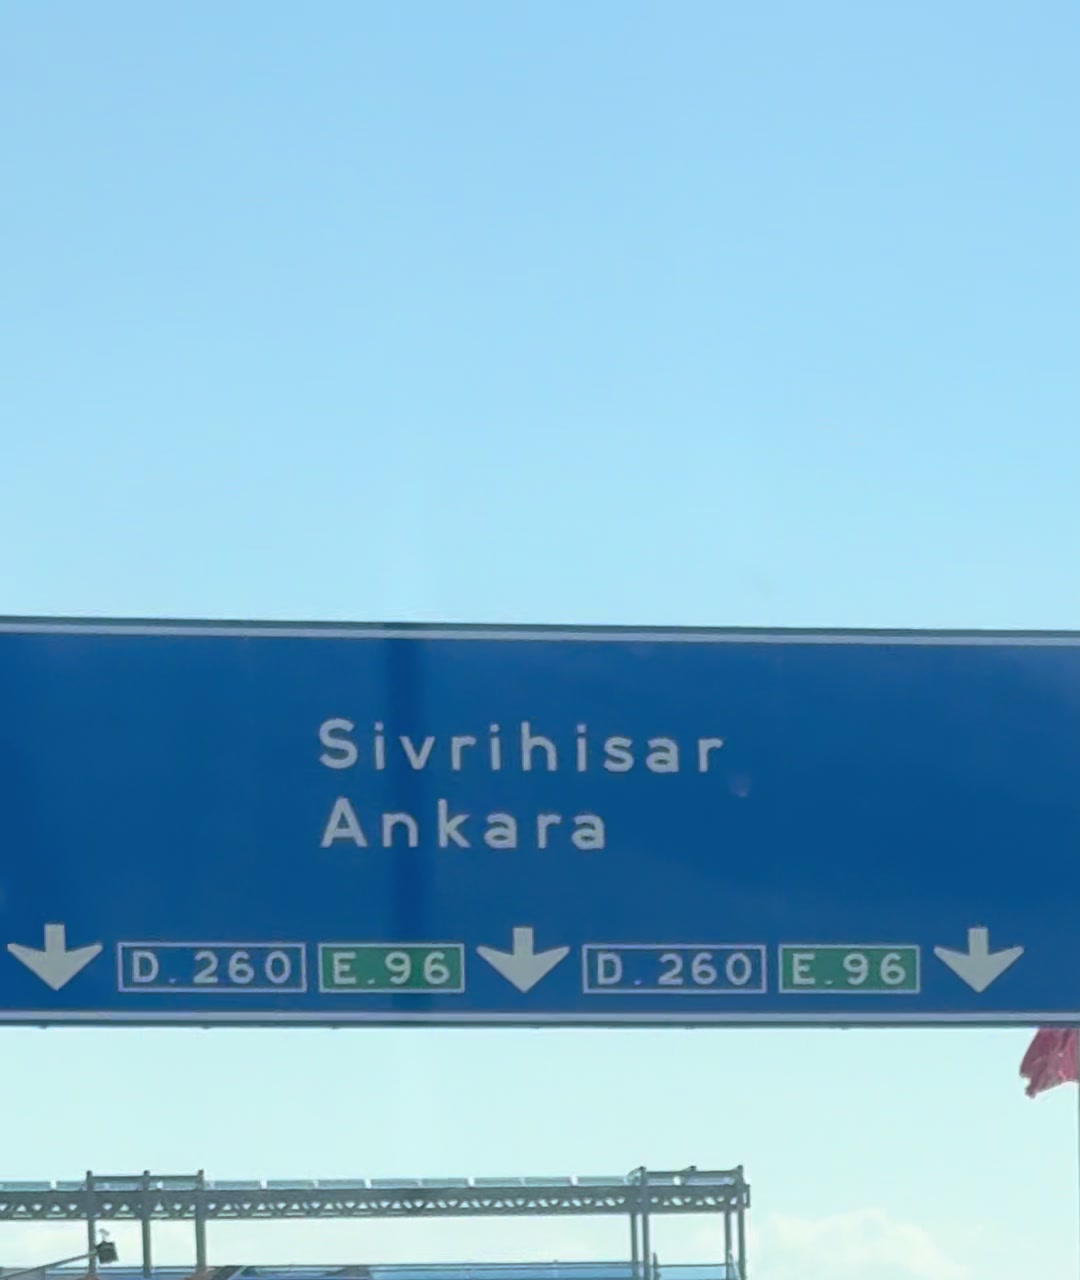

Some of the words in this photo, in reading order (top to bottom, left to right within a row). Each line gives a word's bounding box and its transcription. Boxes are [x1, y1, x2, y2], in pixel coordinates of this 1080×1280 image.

[318, 717, 724, 774] Sivrihisar
[320, 797, 607, 850] Ankara
[332, 951, 451, 985] E.96
[791, 952, 907, 986] E.96
